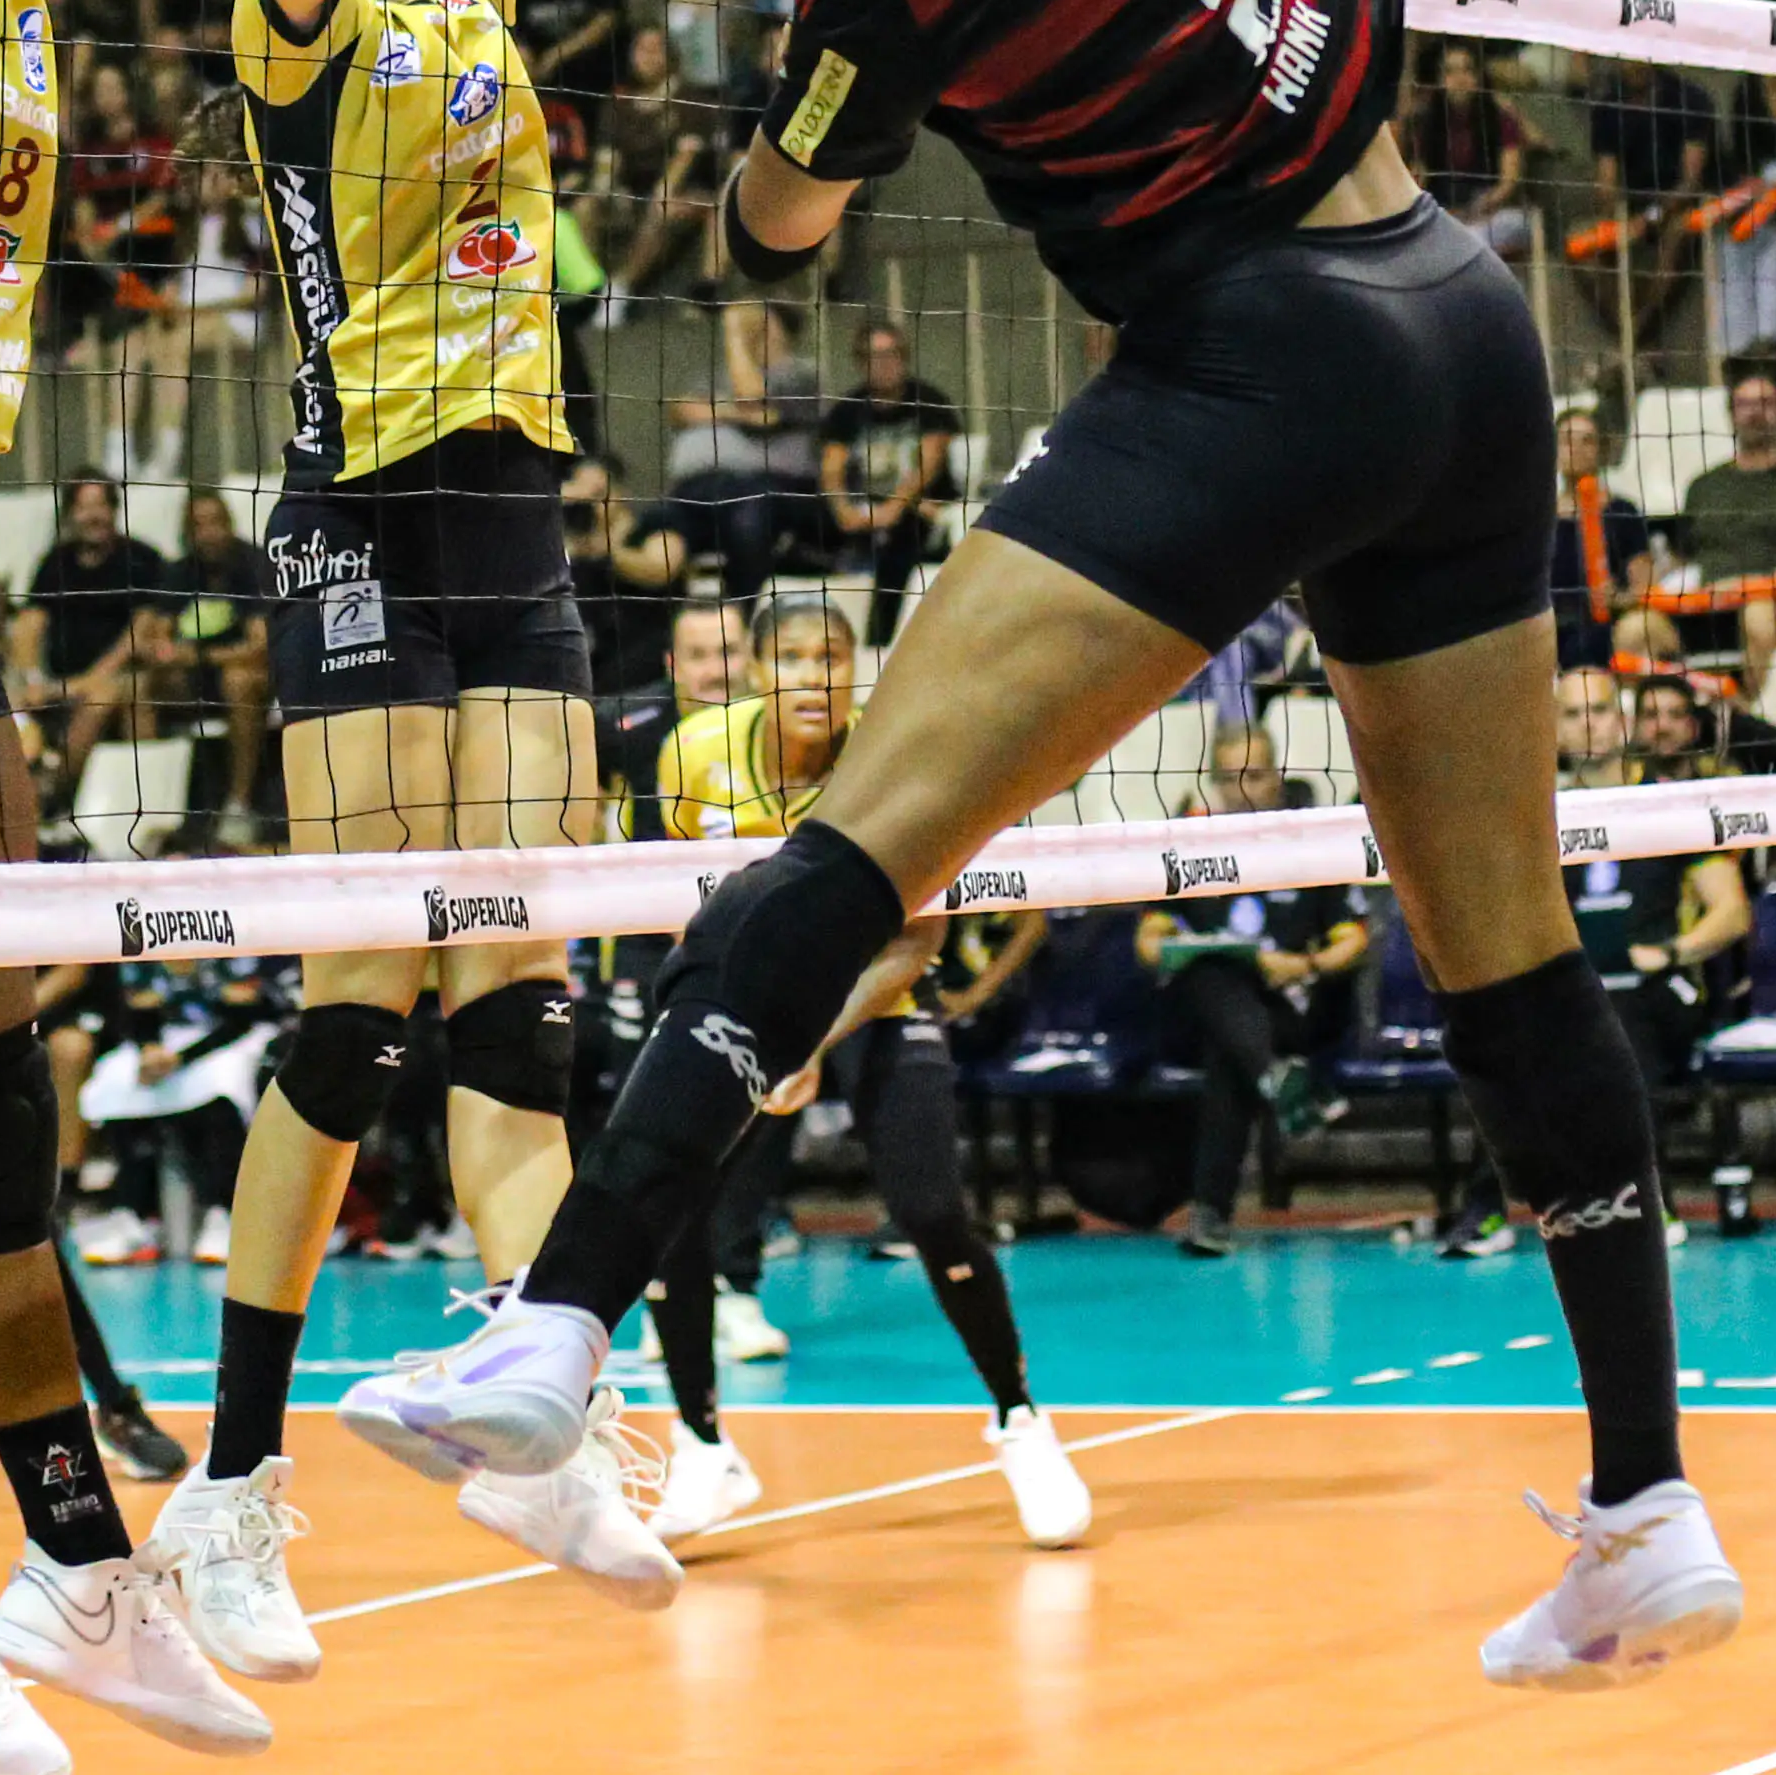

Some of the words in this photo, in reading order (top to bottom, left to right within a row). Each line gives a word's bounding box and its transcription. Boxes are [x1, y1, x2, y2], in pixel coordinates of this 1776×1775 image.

[268, 529, 374, 599] Friboi
[1560, 826, 1610, 857] SUPERLIGA
[1724, 811, 1769, 841] SUPERLIGA
[963, 871, 1027, 904] SUPERLIGA
[1181, 855, 1240, 890] SUPERLIGA
[146, 910, 235, 948] SUPERLIGA
[450, 896, 531, 934] SUPERLIGA
